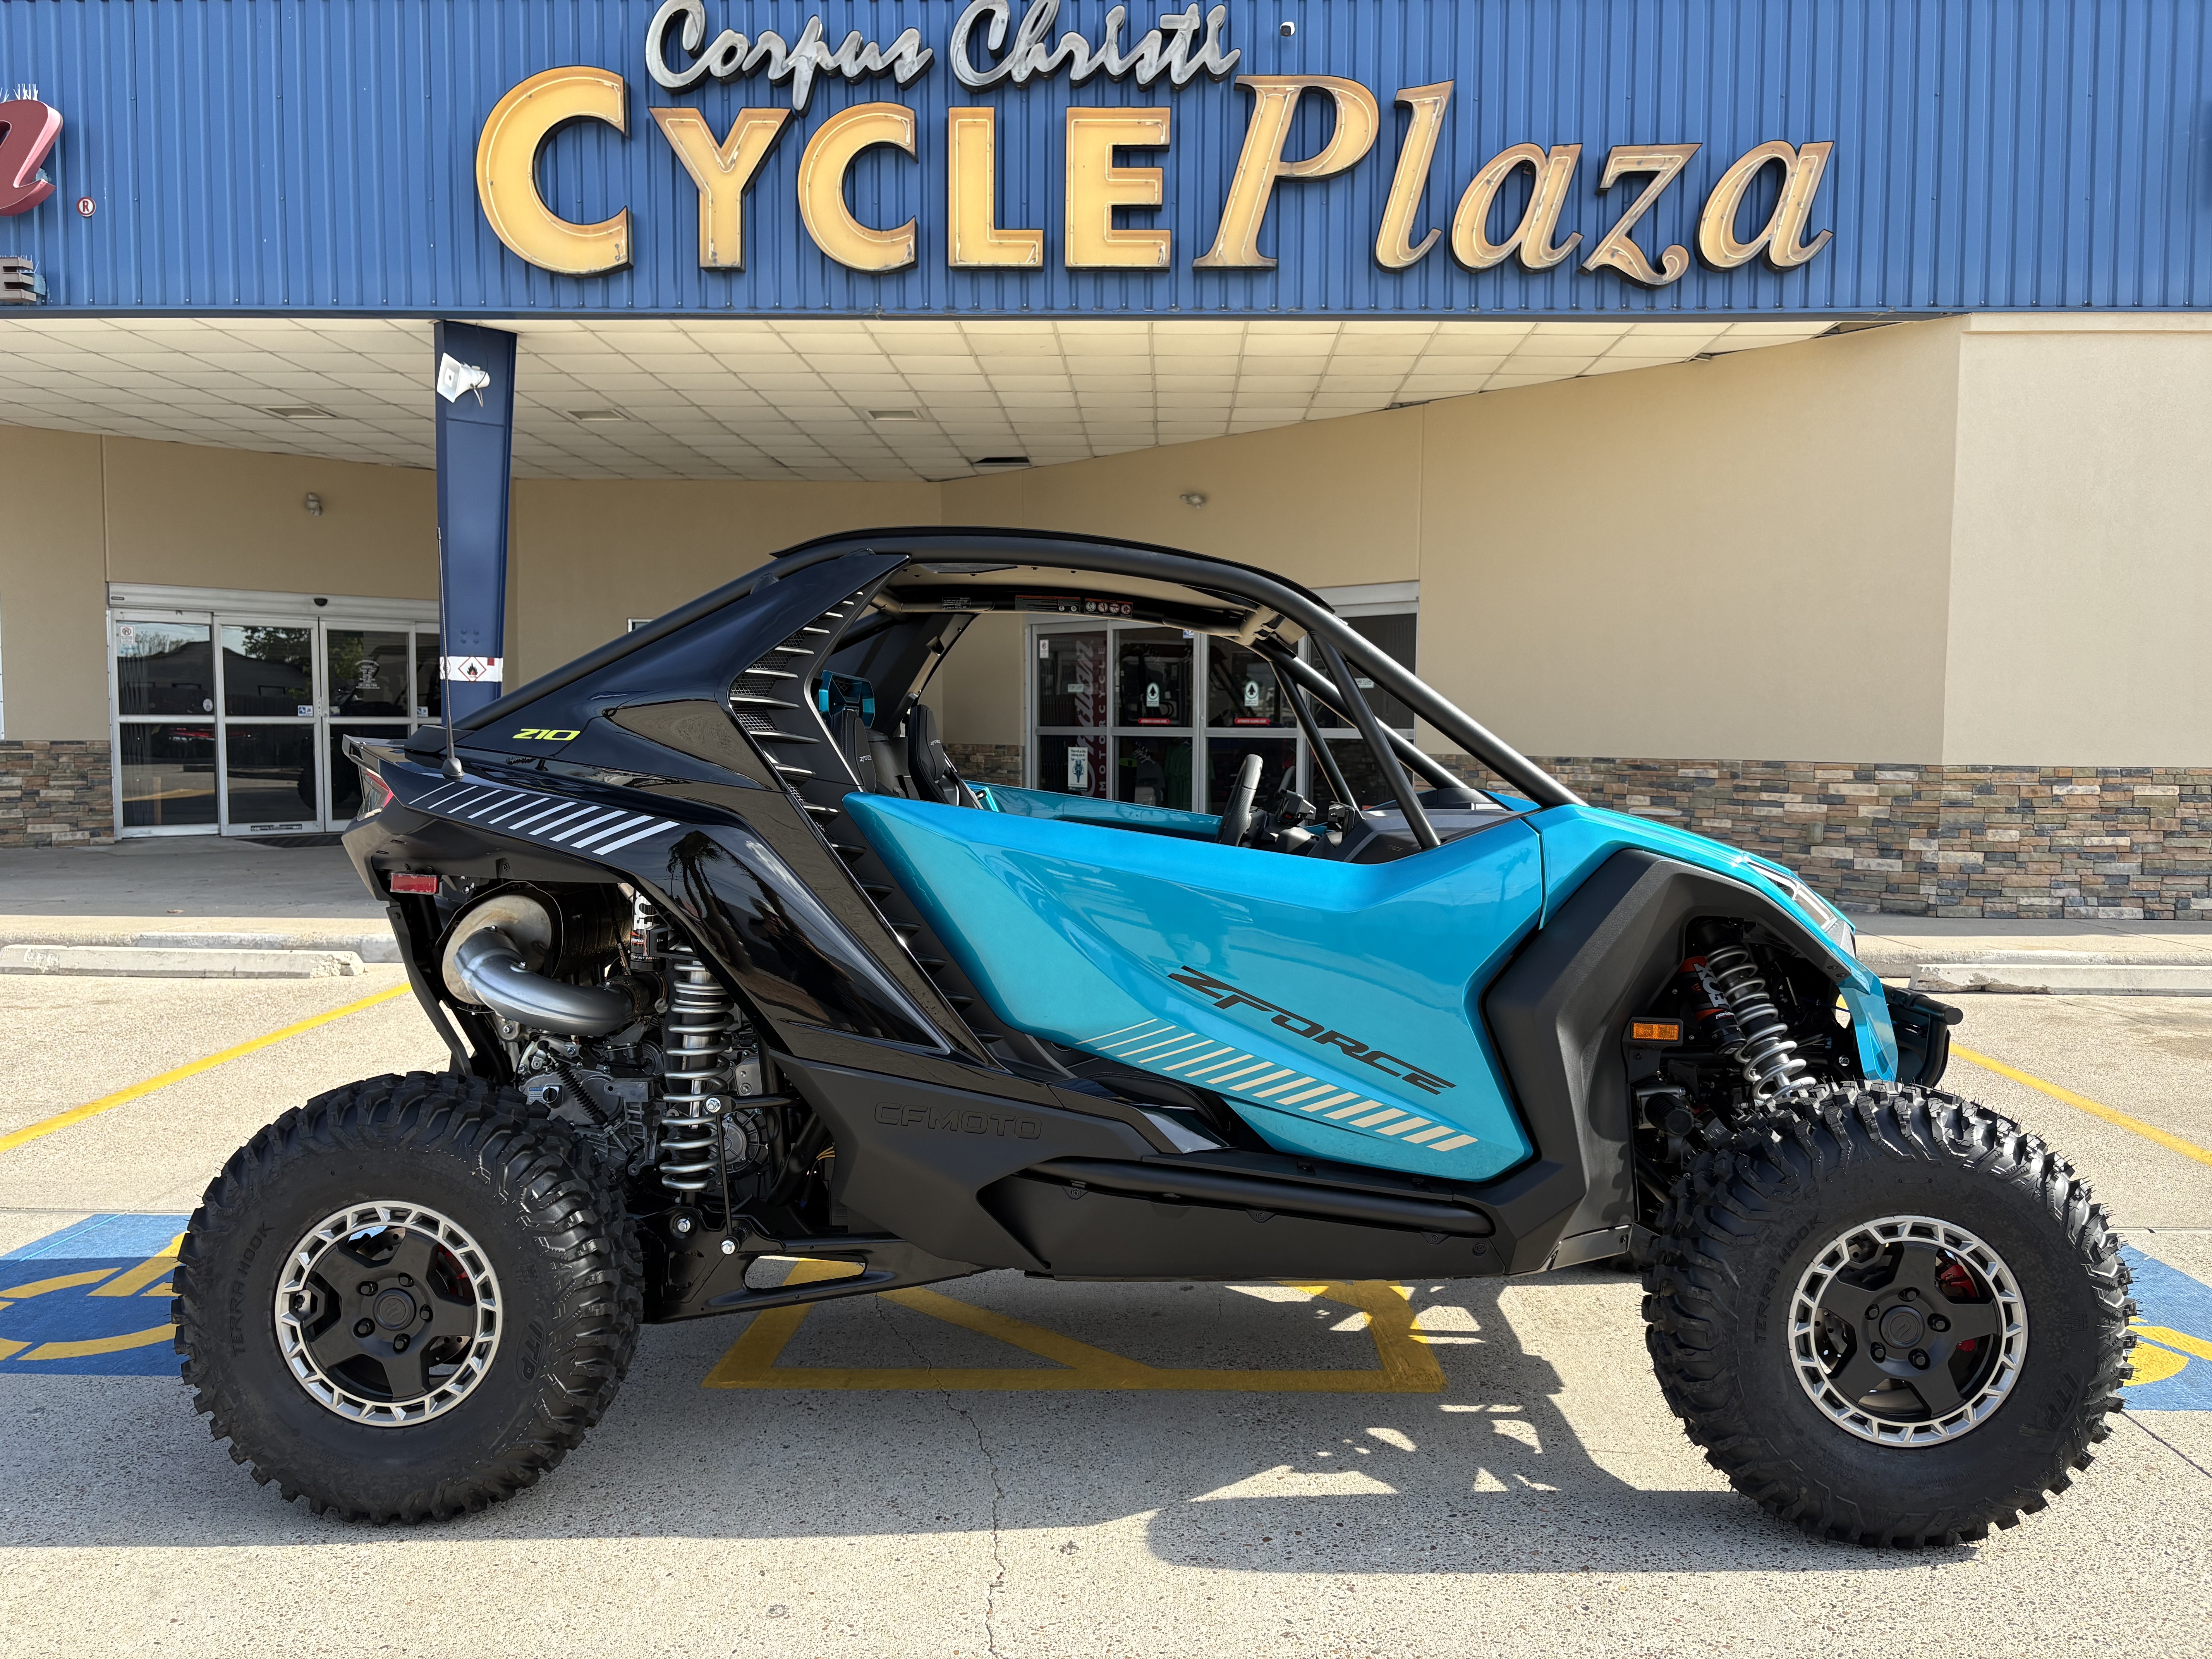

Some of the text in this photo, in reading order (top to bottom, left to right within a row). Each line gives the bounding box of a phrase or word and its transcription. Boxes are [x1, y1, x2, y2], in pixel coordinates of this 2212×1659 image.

[646, 0, 1241, 117] Corpus Christi
[476, 65, 1834, 290] CYCLE Plaza
[512, 728, 580, 741] Z10
[1693, 962, 1731, 1007] FOX
[1167, 965, 1457, 1095] ZFORCE
[874, 1102, 1042, 1139] CFMOTO
[237, 1222, 276, 1278] HOOK
[1778, 1215, 1824, 1266] HOOK
[228, 1283, 246, 1357] TERRA
[1754, 1268, 1781, 1344] TERRA
[521, 1320, 545, 1379] ITP
[2046, 1373, 2083, 1430] ITP
